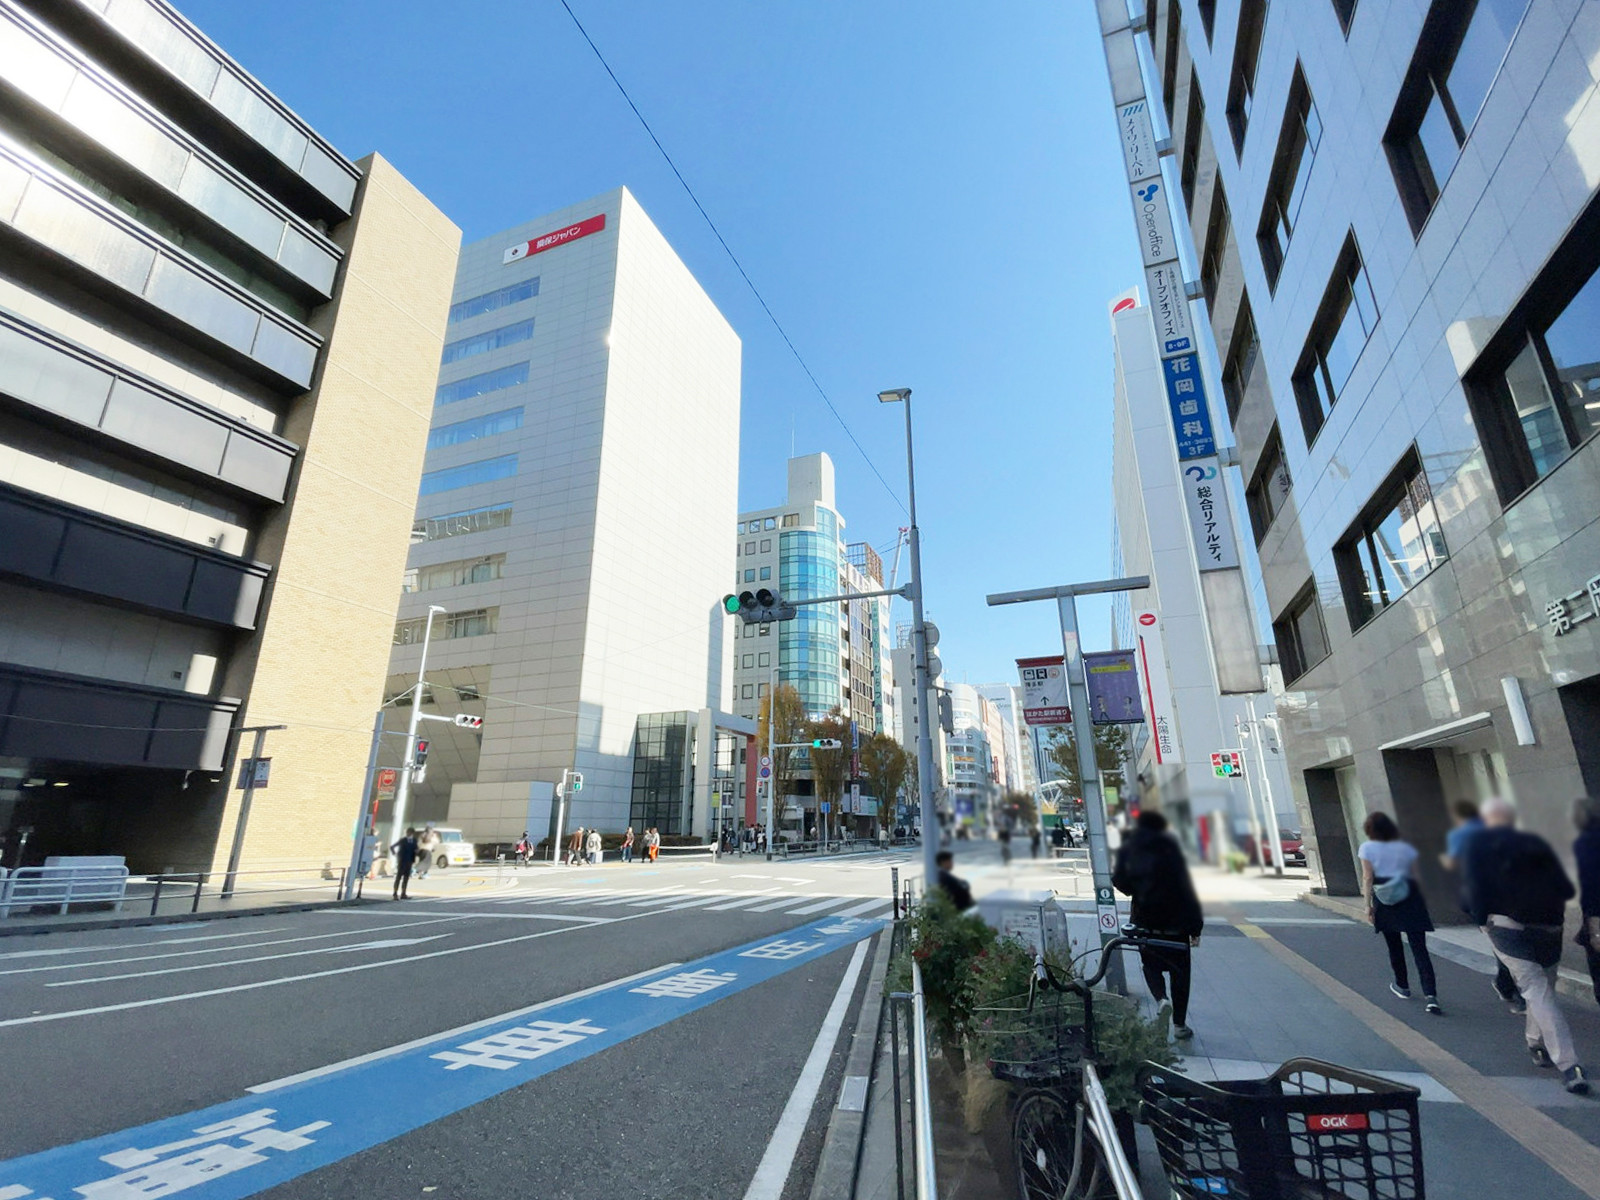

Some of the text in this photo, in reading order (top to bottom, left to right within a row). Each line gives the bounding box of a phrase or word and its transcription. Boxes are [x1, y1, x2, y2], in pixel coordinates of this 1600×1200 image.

[1153, 269, 1176, 337] オープンオフィス
[1171, 357, 1203, 437] 花岡歯科
[1188, 444, 1206, 456] 3F
[1197, 486, 1222, 562] 総合リアルティ
[1320, 1116, 1349, 1128] OGK
